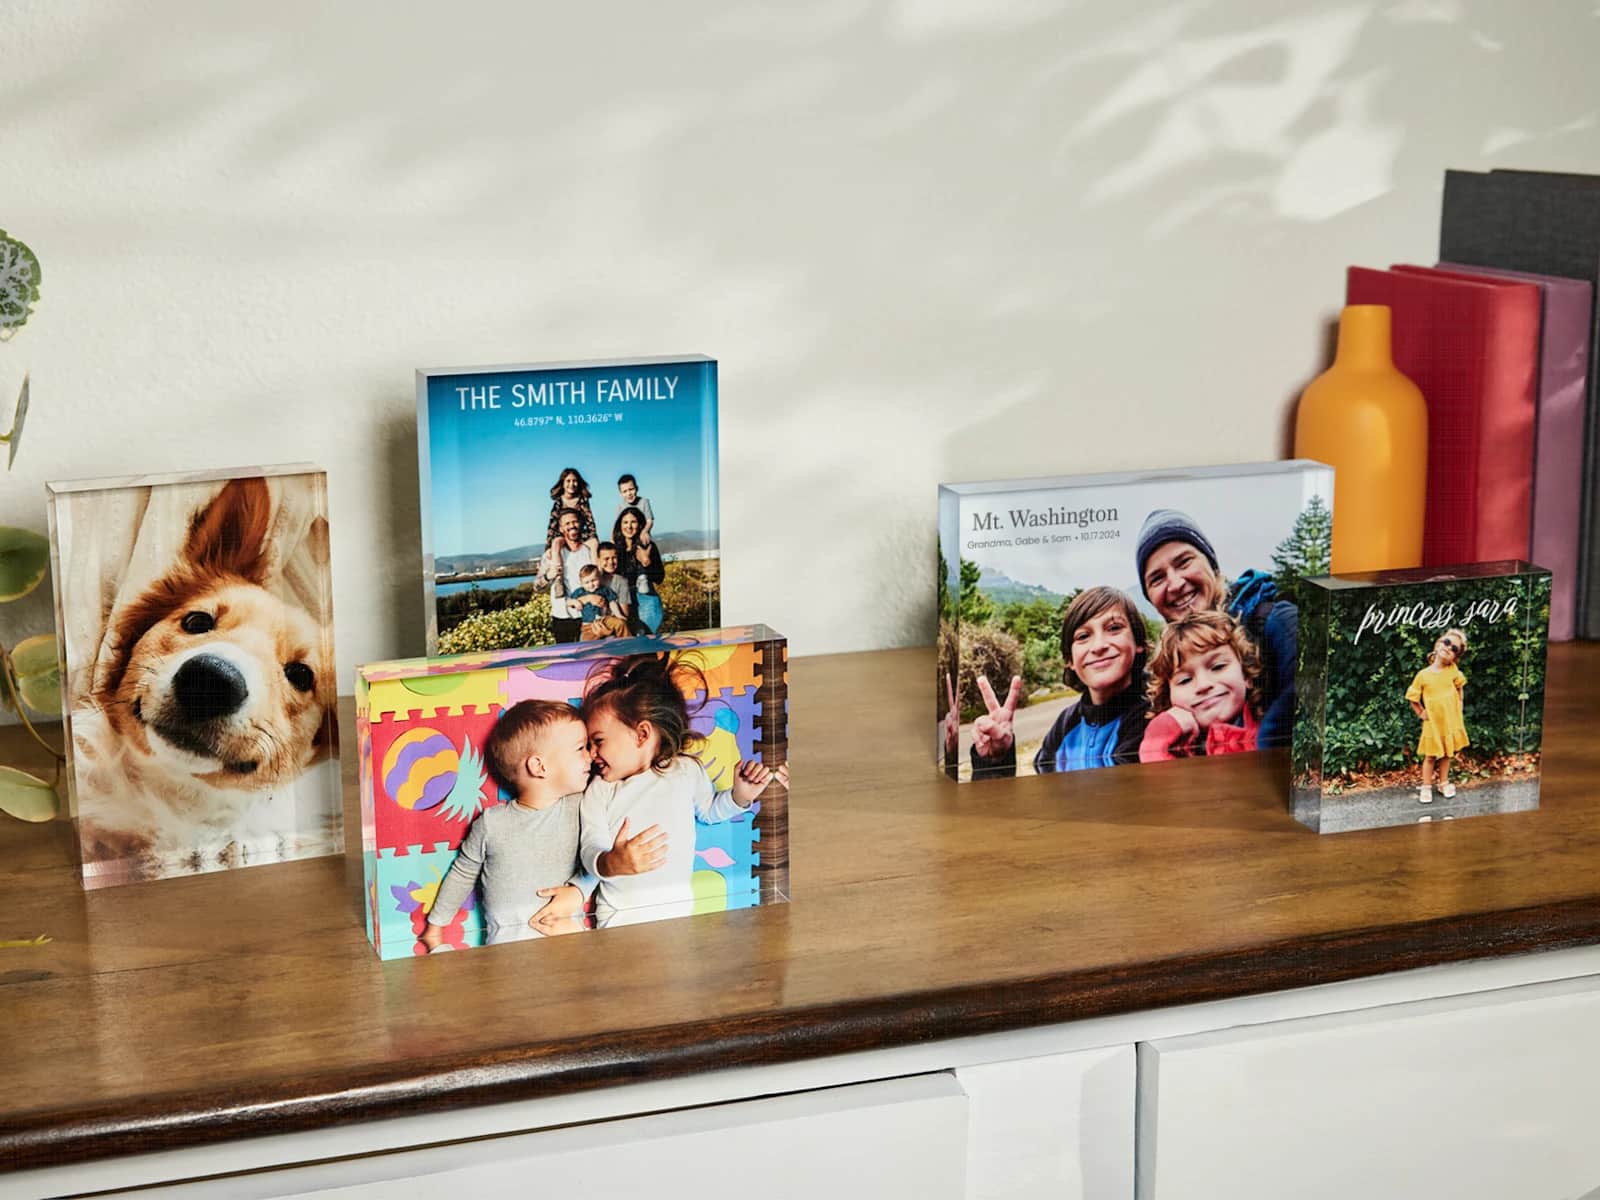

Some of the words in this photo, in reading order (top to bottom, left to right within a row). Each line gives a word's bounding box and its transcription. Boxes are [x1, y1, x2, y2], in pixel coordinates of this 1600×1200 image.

[456, 386, 501, 410] THE
[511, 380, 585, 408] SMITH
[597, 376, 679, 403] FAMILY
[614, 412, 624, 422] W
[972, 511, 1004, 531] Mt.
[1008, 506, 1119, 528] Washington
[1015, 534, 1041, 547] Gabe
[1042, 535, 1049, 544] &
[1051, 534, 1072, 544] Sam
[1353, 601, 1456, 646] princess
[1458, 596, 1519, 627] sara
